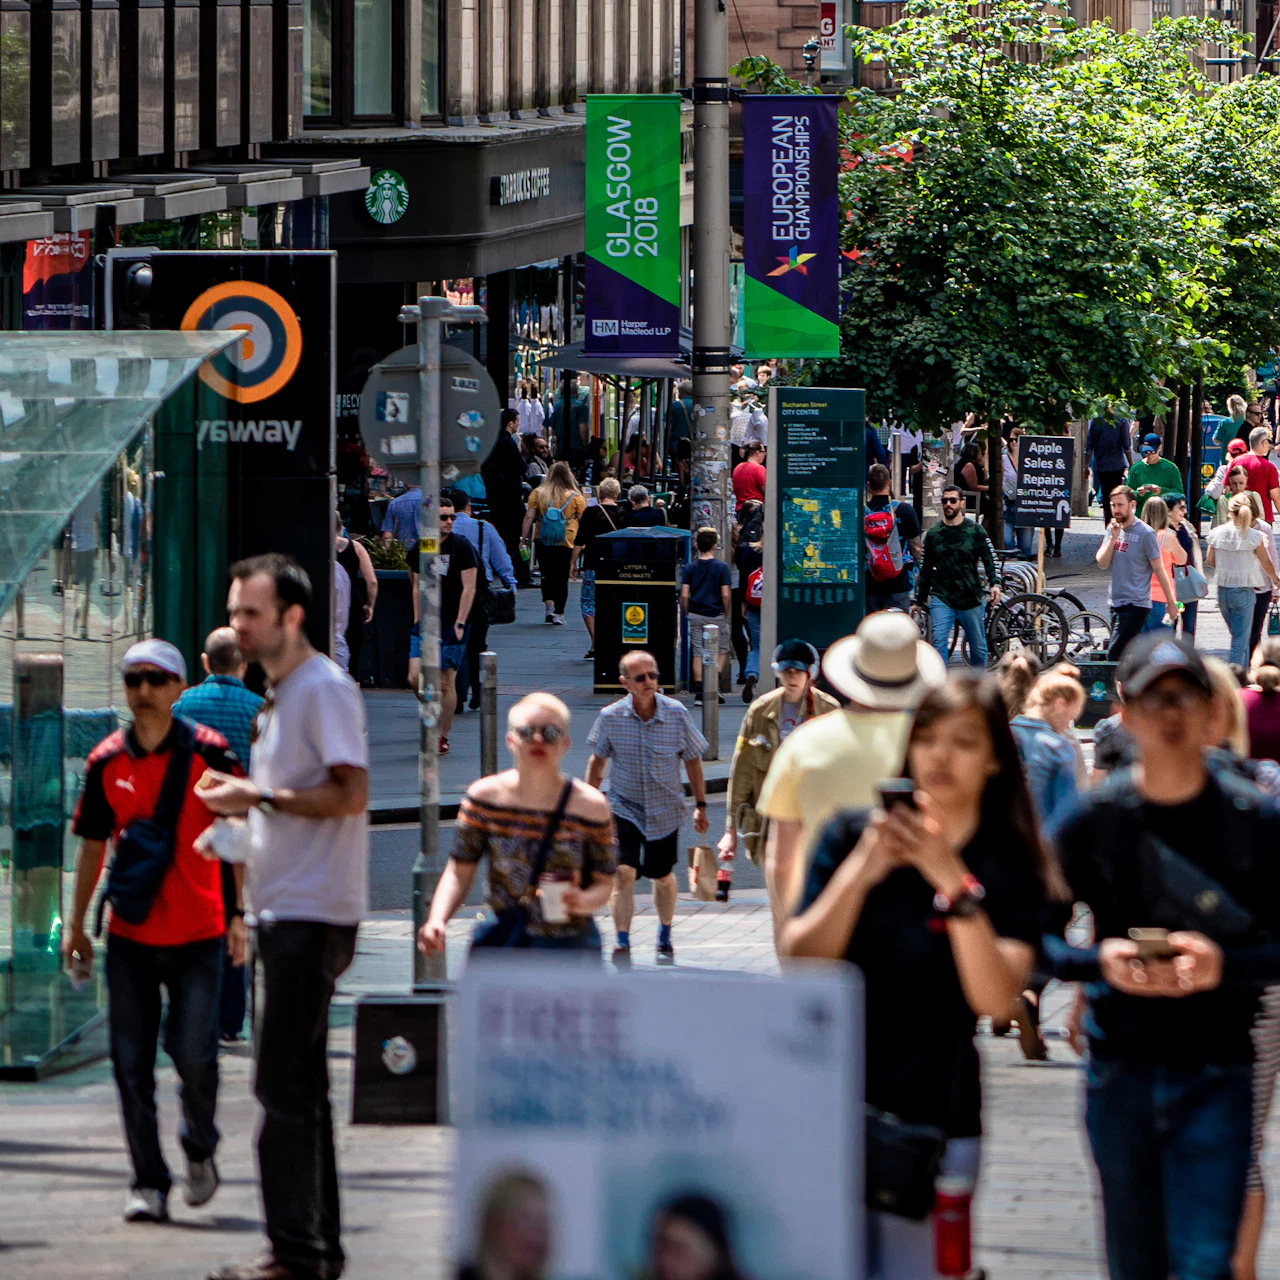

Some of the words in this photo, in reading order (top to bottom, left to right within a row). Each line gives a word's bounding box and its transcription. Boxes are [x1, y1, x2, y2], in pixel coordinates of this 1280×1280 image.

[772, 115, 794, 241] EUROPEAN
[794, 115, 811, 241] CHAMPIONSHIPS
[500, 170, 531, 206] STARBUCKS
[531, 167, 550, 199] COFFEE
[606, 116, 632, 258] GLASGOW
[634, 197, 659, 258] 2018
[595, 321, 616, 333] HM
[621, 320, 648, 328] Harper
[621, 328, 654, 336] Macleod
[655, 328, 671, 336] LLP
[1028, 442, 1062, 455] Apple
[1023, 457, 1053, 469] Sales
[1055, 458, 1066, 469] &
[1023, 474, 1065, 487] Repairs
